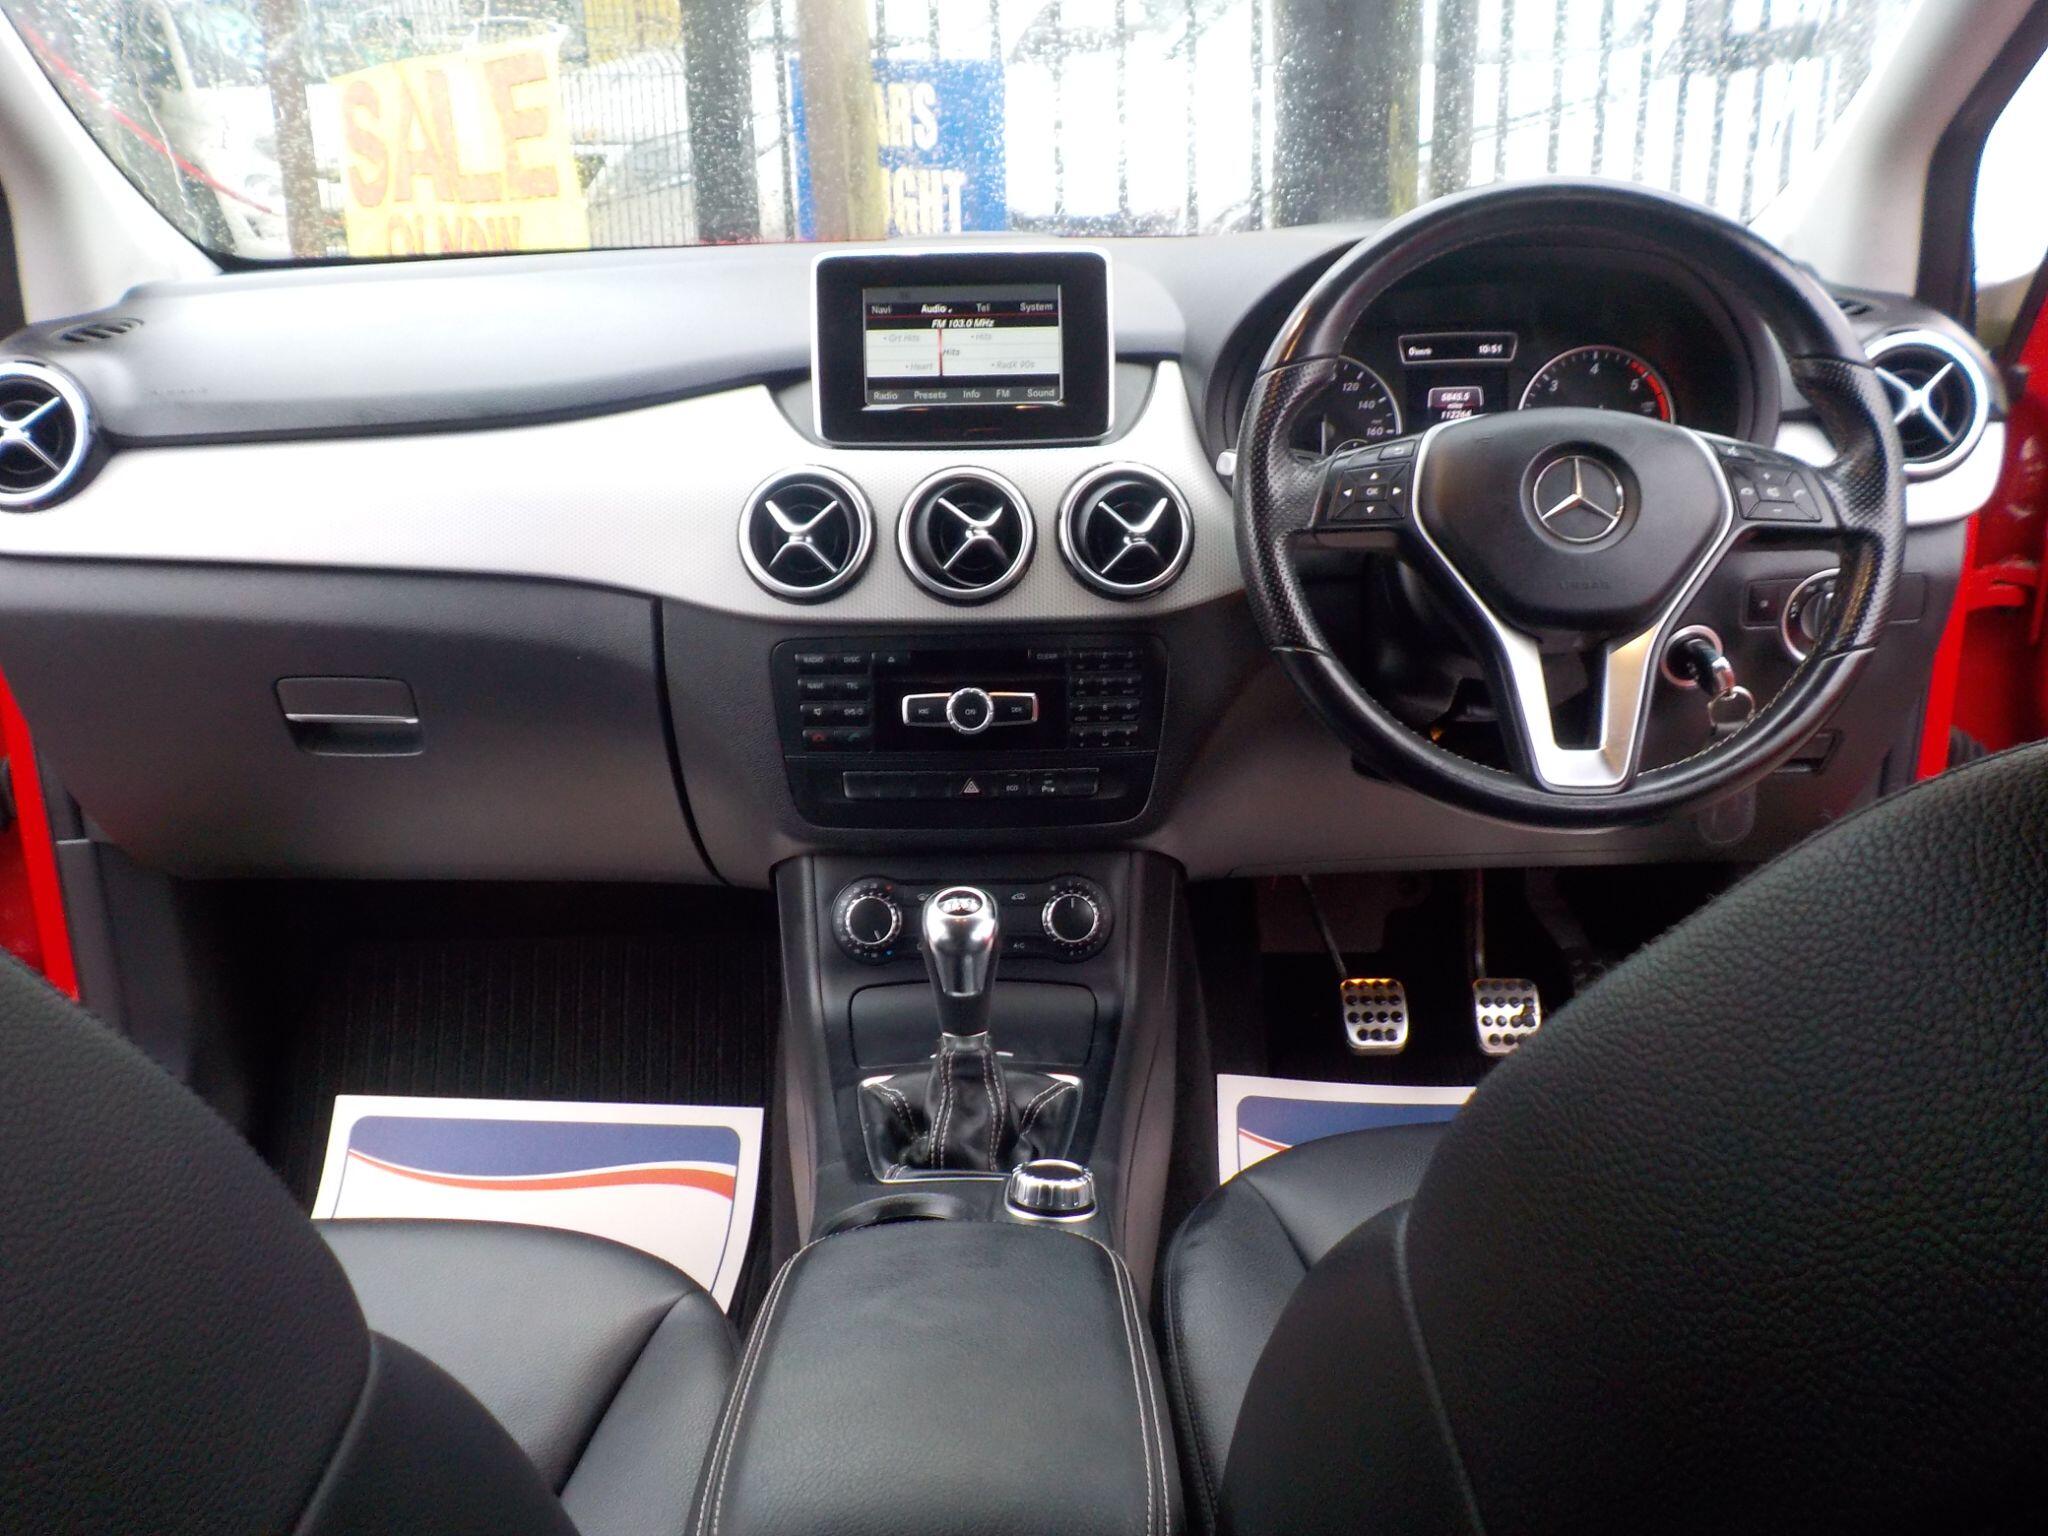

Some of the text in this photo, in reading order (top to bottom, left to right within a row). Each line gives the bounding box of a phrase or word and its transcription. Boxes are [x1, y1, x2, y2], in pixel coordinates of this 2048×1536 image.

[344, 53, 560, 207] SALE
[872, 302, 1054, 314] Navi Audio Tel System
[931, 318, 995, 328] FM 103.0 MHz
[1589, 362, 1600, 375] 4
[1342, 382, 1360, 392] 120
[1549, 379, 1559, 392] 3
[1630, 378, 1640, 391] 5
[873, 388, 1055, 400] Radio Presets Info FM Sound
[1358, 400, 1376, 410] 140
[1366, 425, 1384, 436] 160
